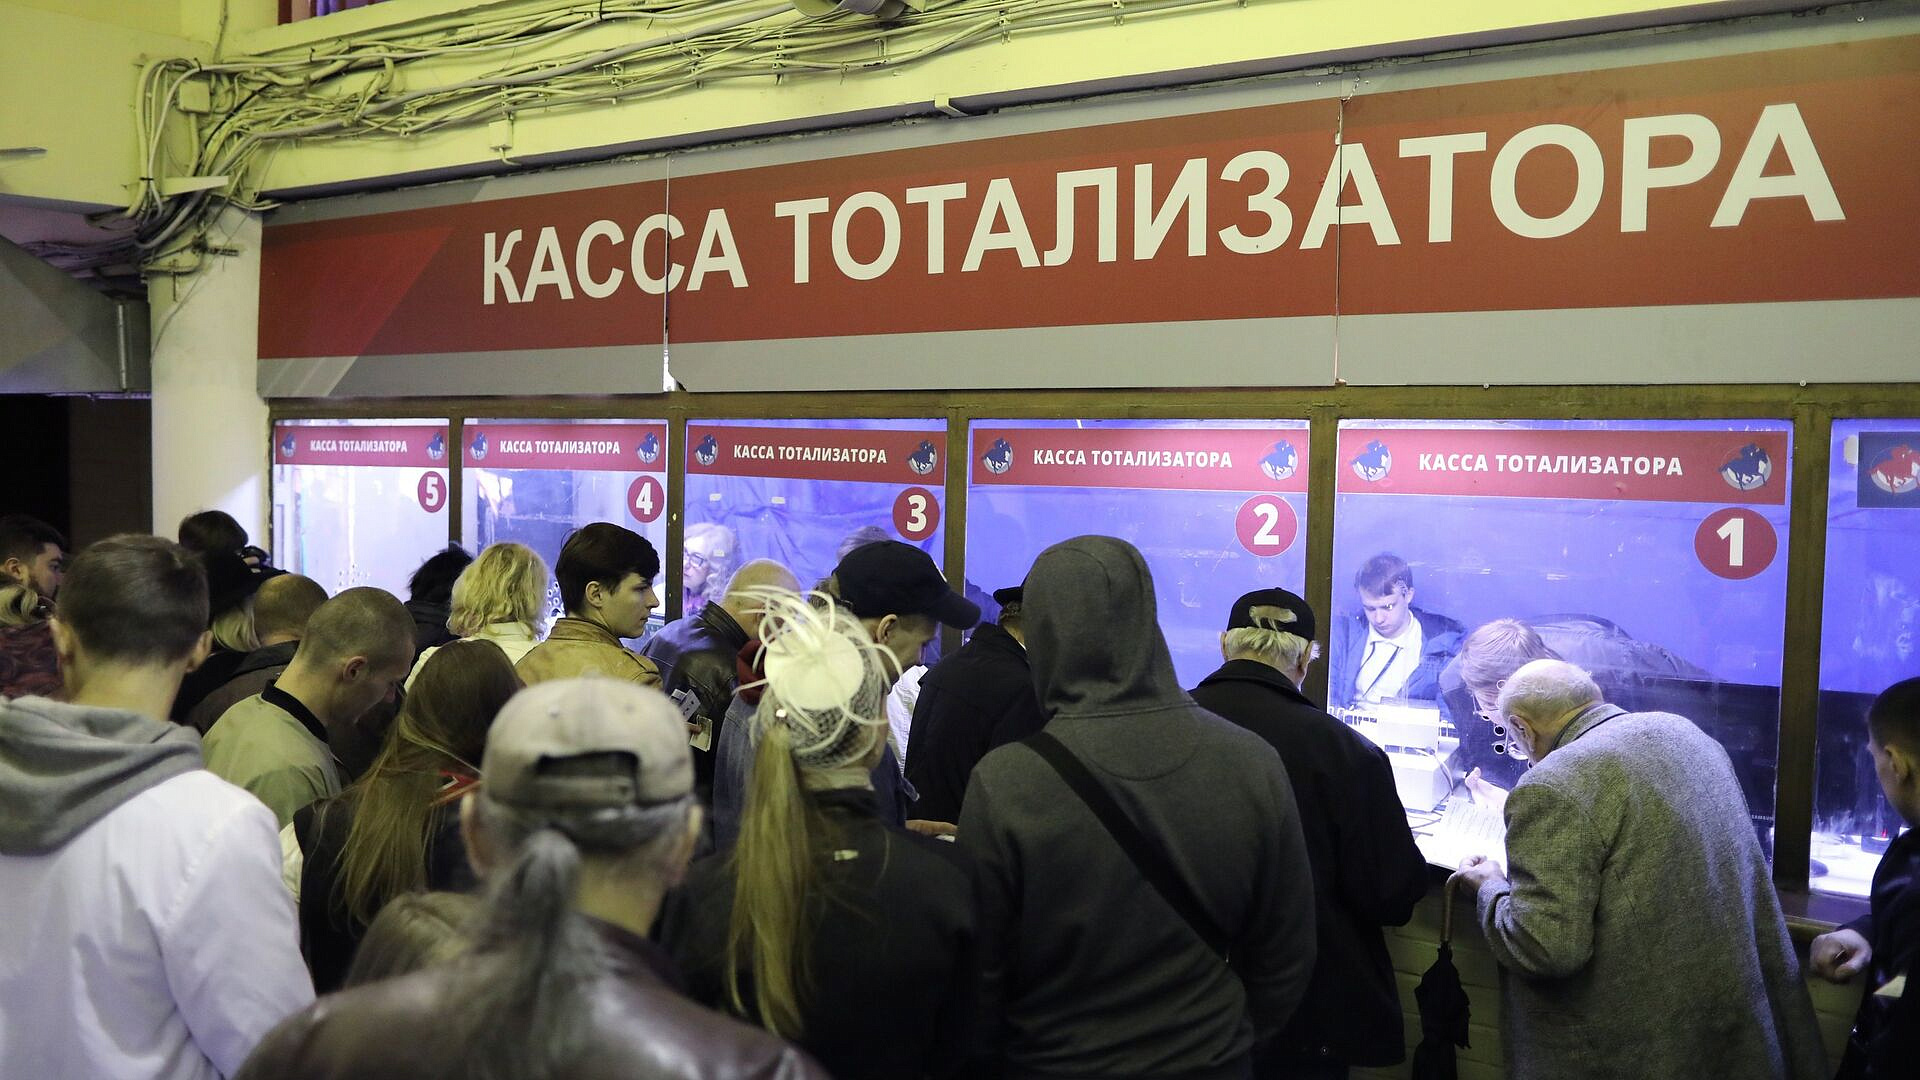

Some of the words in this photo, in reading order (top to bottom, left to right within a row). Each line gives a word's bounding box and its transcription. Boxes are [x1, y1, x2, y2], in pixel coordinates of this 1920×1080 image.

[483, 207, 748, 305] КАССА
[775, 102, 1846, 284] ТОТАЛИЗАТОРА
[310, 440, 336, 452] КАССА
[338, 440, 408, 453] ТОТАЛИЗАТОРА
[500, 440, 533, 454] КАССА
[535, 441, 621, 455] ТОТАЛИЗАТОРА
[733, 444, 775, 460] КАССА
[778, 446, 887, 464] ТОТАЛИЗАТОРА
[1033, 449, 1086, 466] КАССА
[1091, 450, 1233, 469] ТОТАЛИЗАТОРА
[1419, 453, 1489, 473] КАССА
[1495, 454, 1683, 477] ТОТАЛИЗАТОРА
[425, 477, 439, 507] 5
[635, 482, 654, 515] 4
[906, 495, 928, 532] 3
[1253, 504, 1280, 546] 2
[1716, 518, 1744, 567] 1
